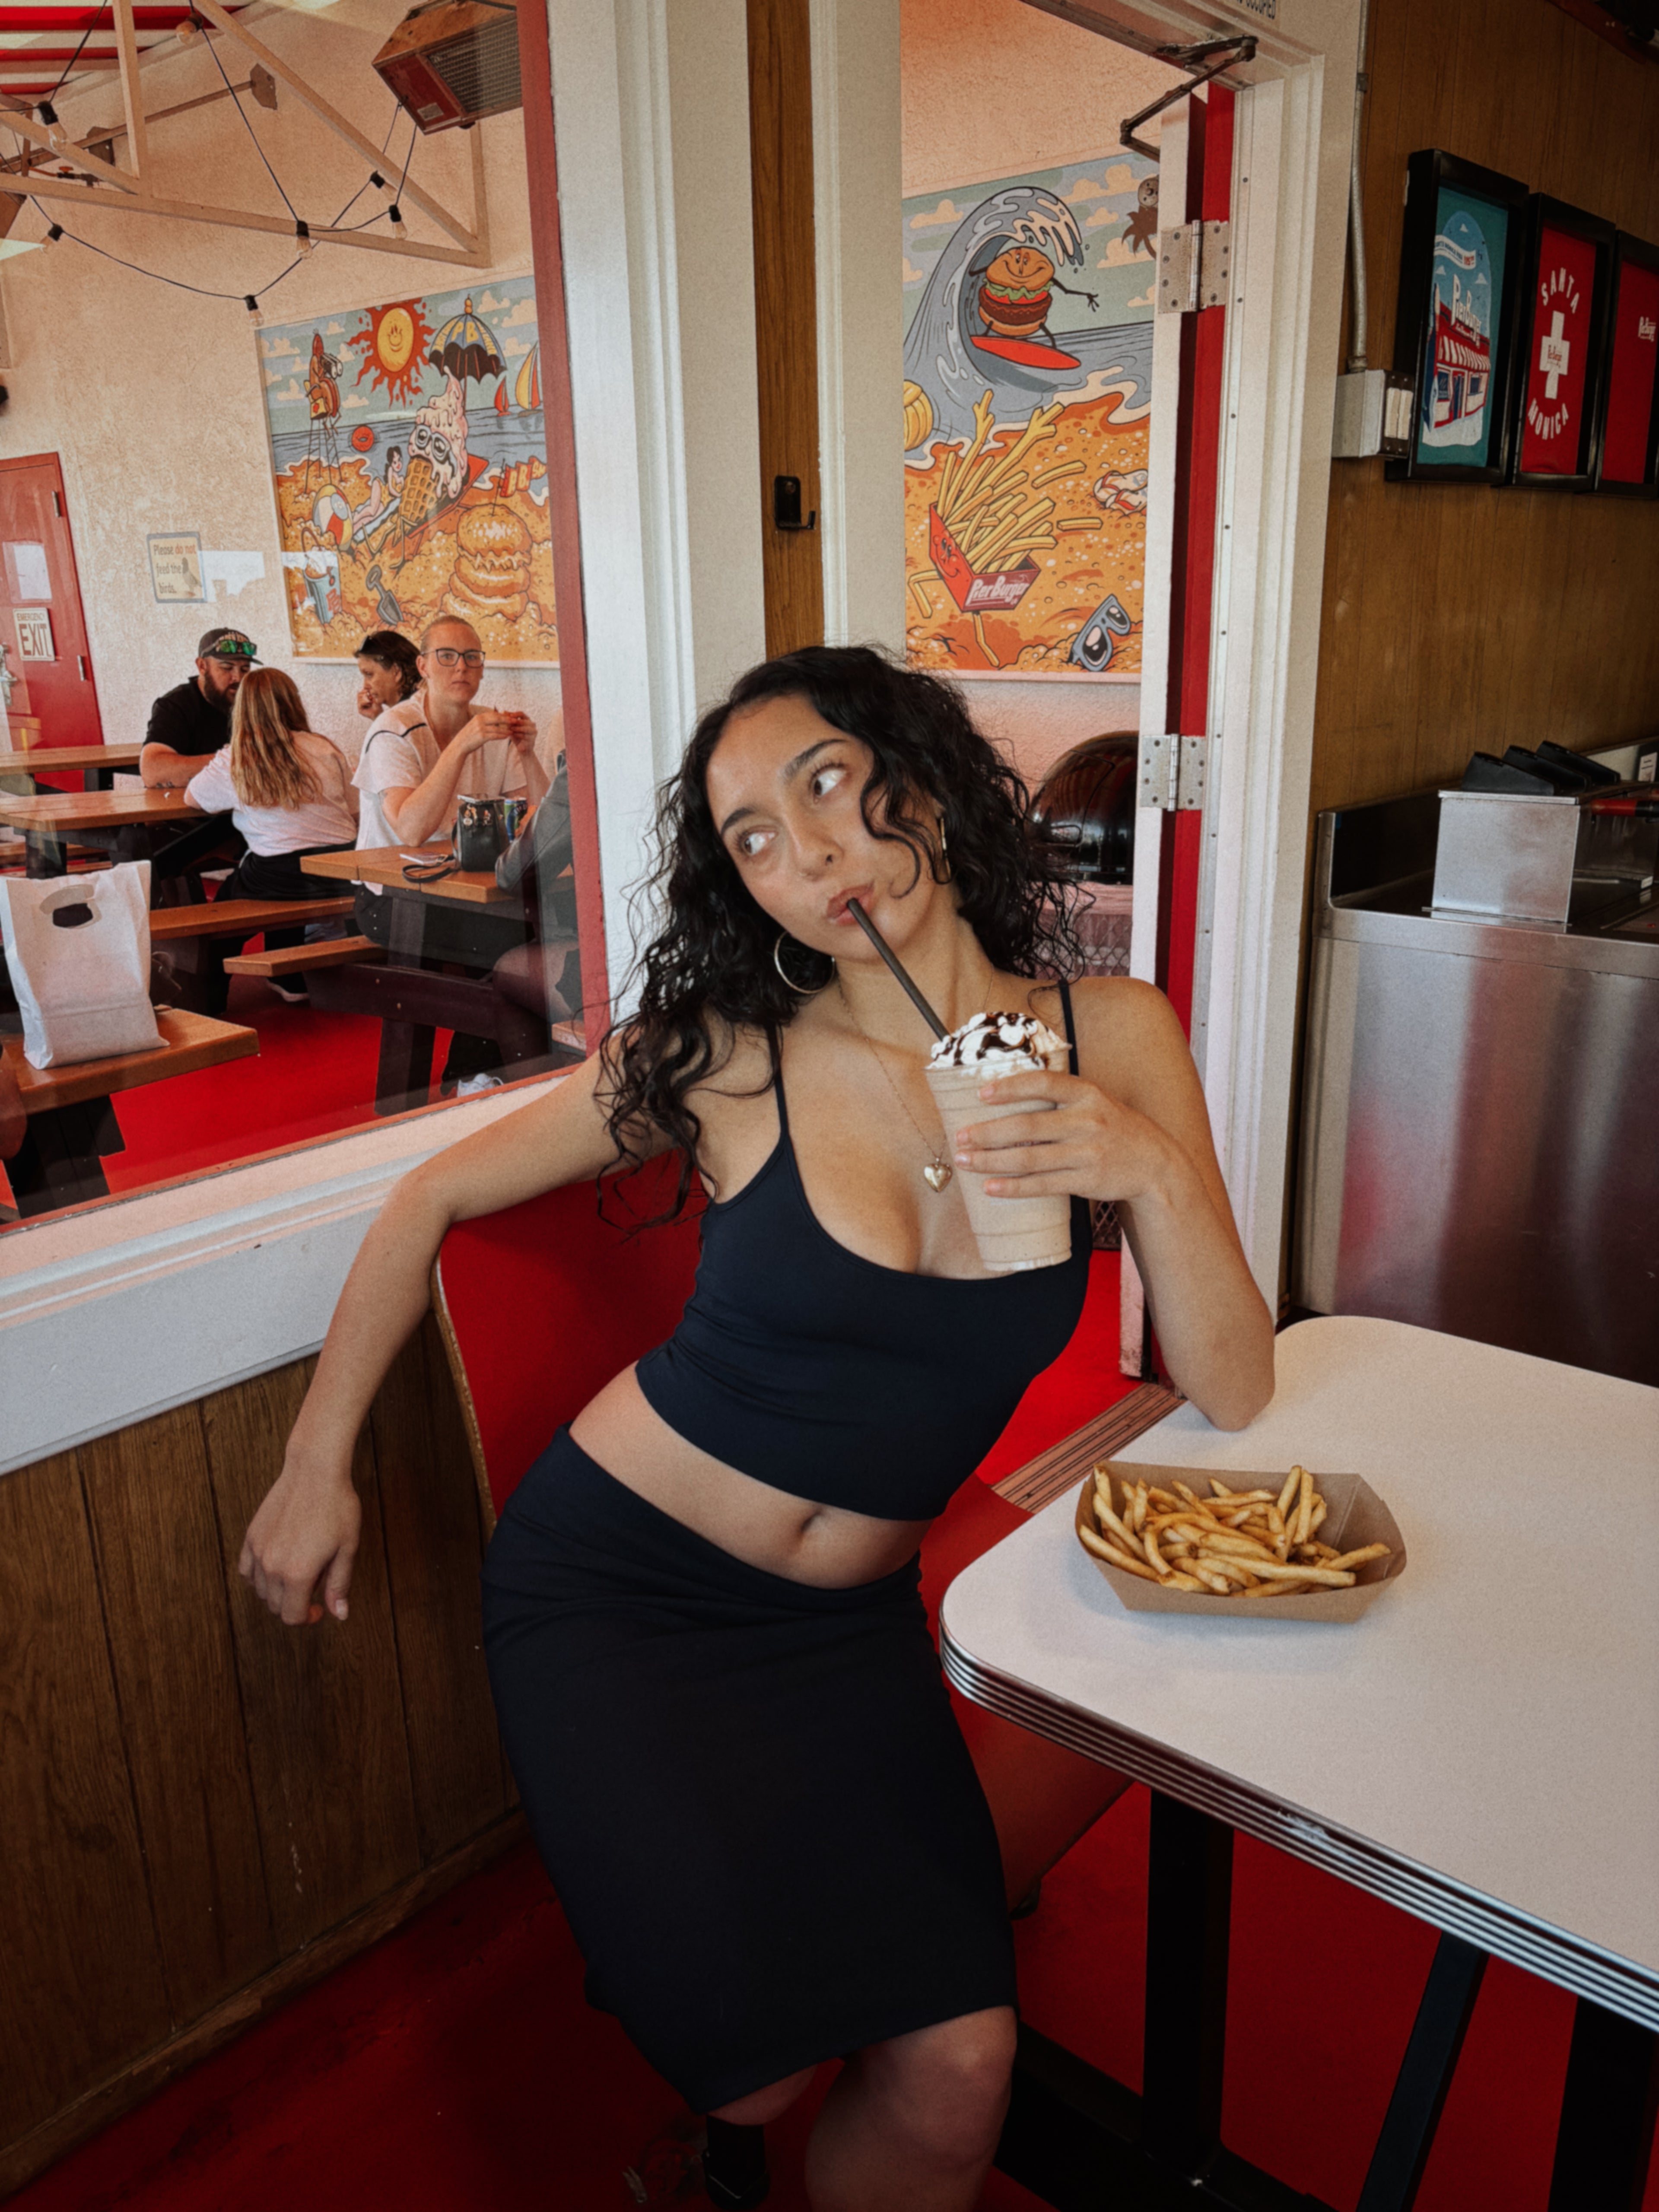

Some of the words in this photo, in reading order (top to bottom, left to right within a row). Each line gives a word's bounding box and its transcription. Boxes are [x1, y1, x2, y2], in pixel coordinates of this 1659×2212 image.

[1541, 267, 1580, 314] SANTA
[1528, 397, 1569, 440] MONICA
[153, 544, 174, 556] Please
[175, 543, 183, 554] do
[184, 544, 197, 554] not
[156, 563, 170, 578] feed
[170, 563, 181, 574] the
[18, 623, 52, 657] EXIT
